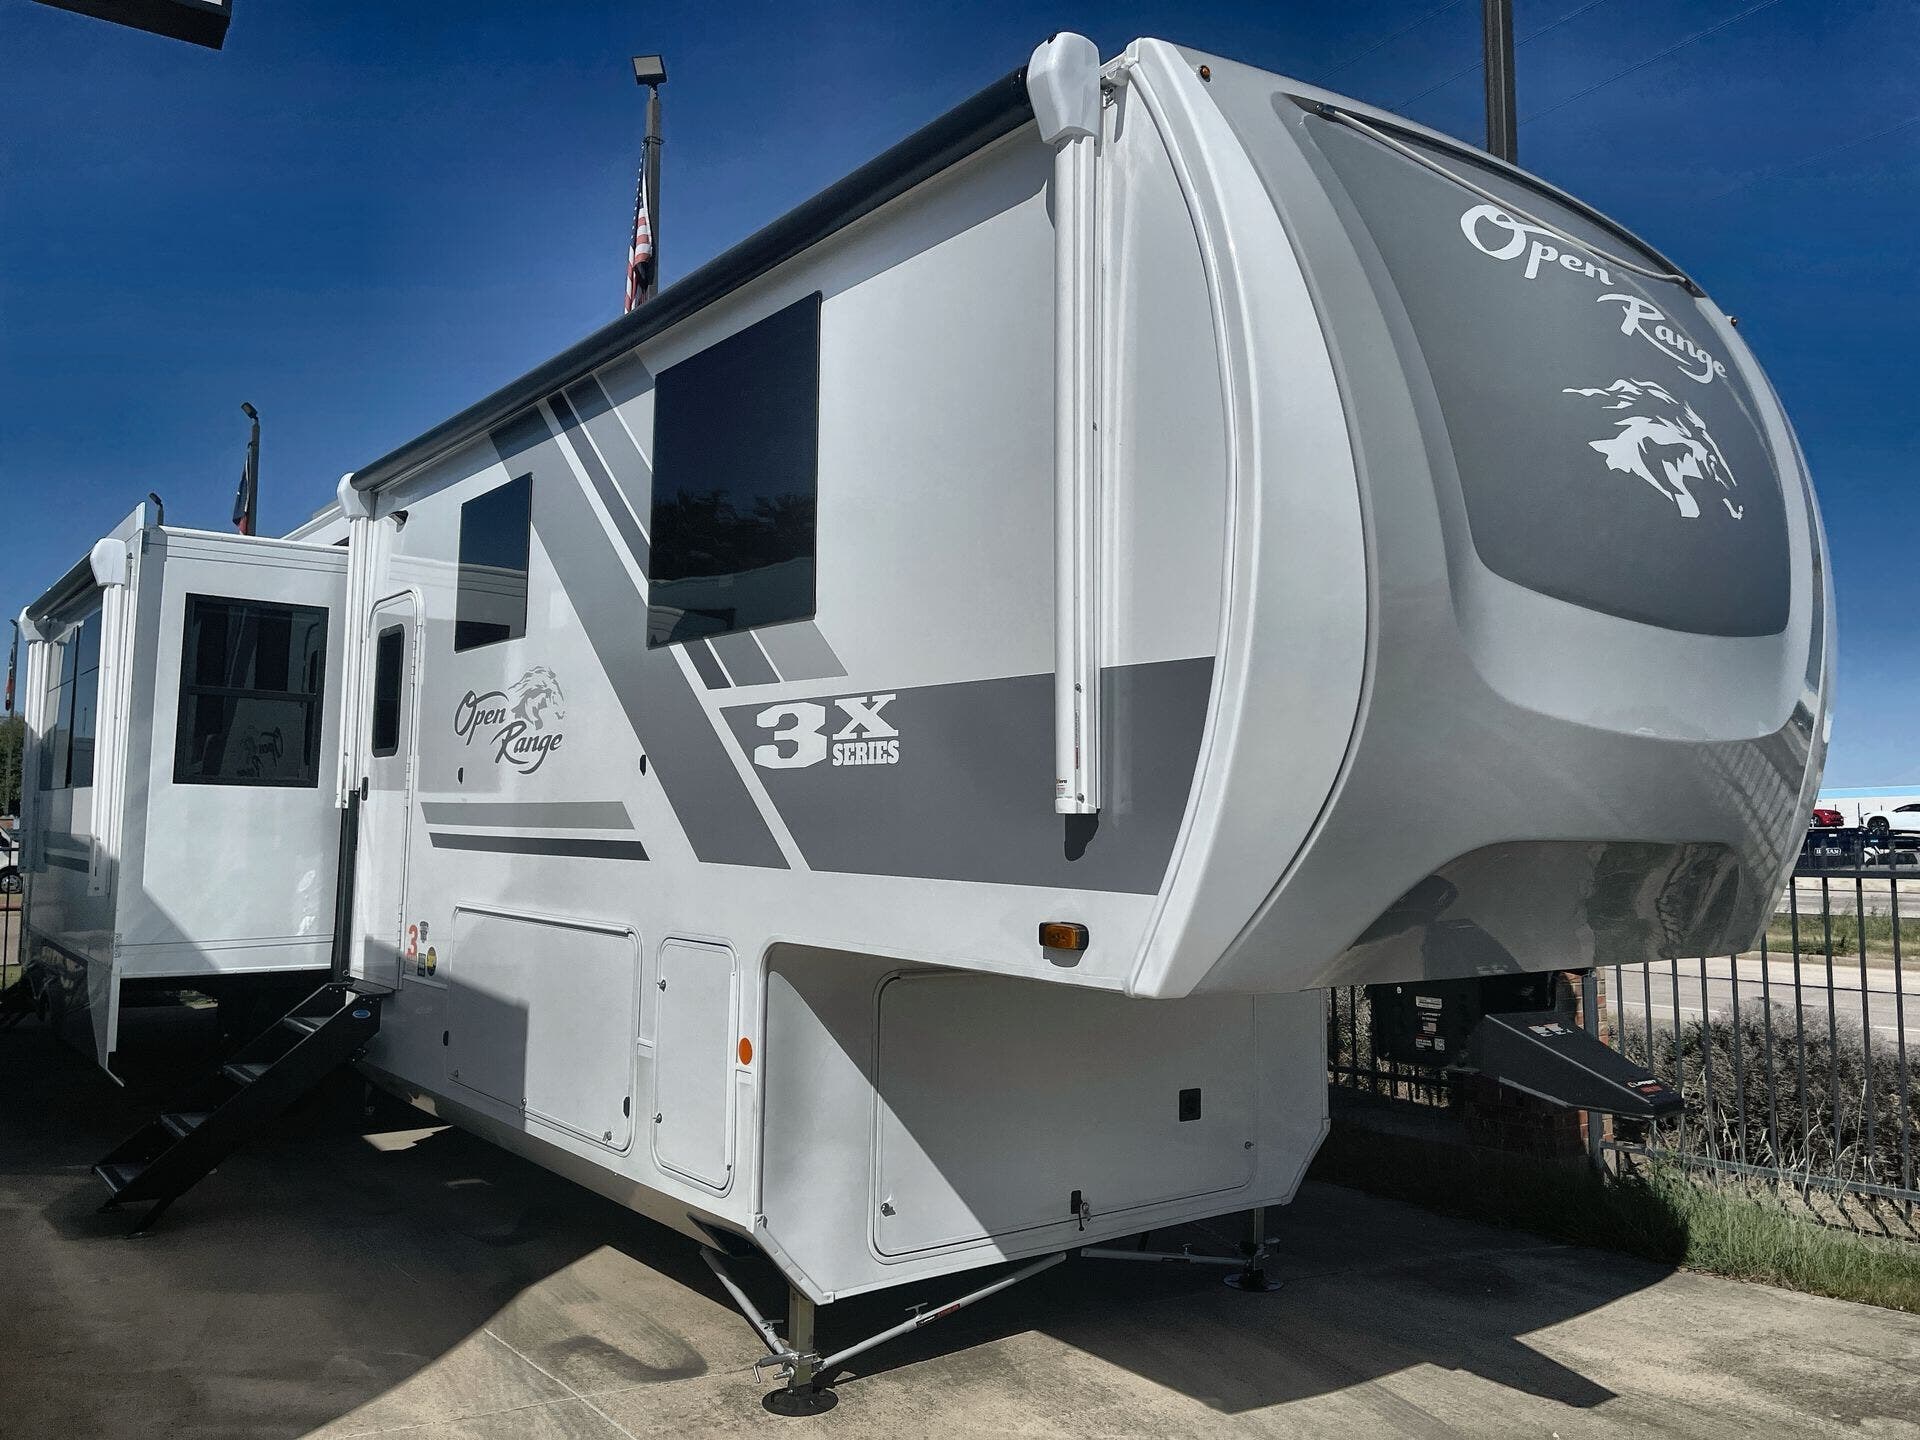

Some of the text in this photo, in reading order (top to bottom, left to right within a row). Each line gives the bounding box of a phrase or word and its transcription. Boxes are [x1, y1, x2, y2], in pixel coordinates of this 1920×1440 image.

[1460, 204, 1614, 286] Open
[1597, 293, 1728, 384] Range
[454, 690, 510, 746] Open
[489, 720, 563, 775] Range
[832, 740, 900, 767] SERIES
